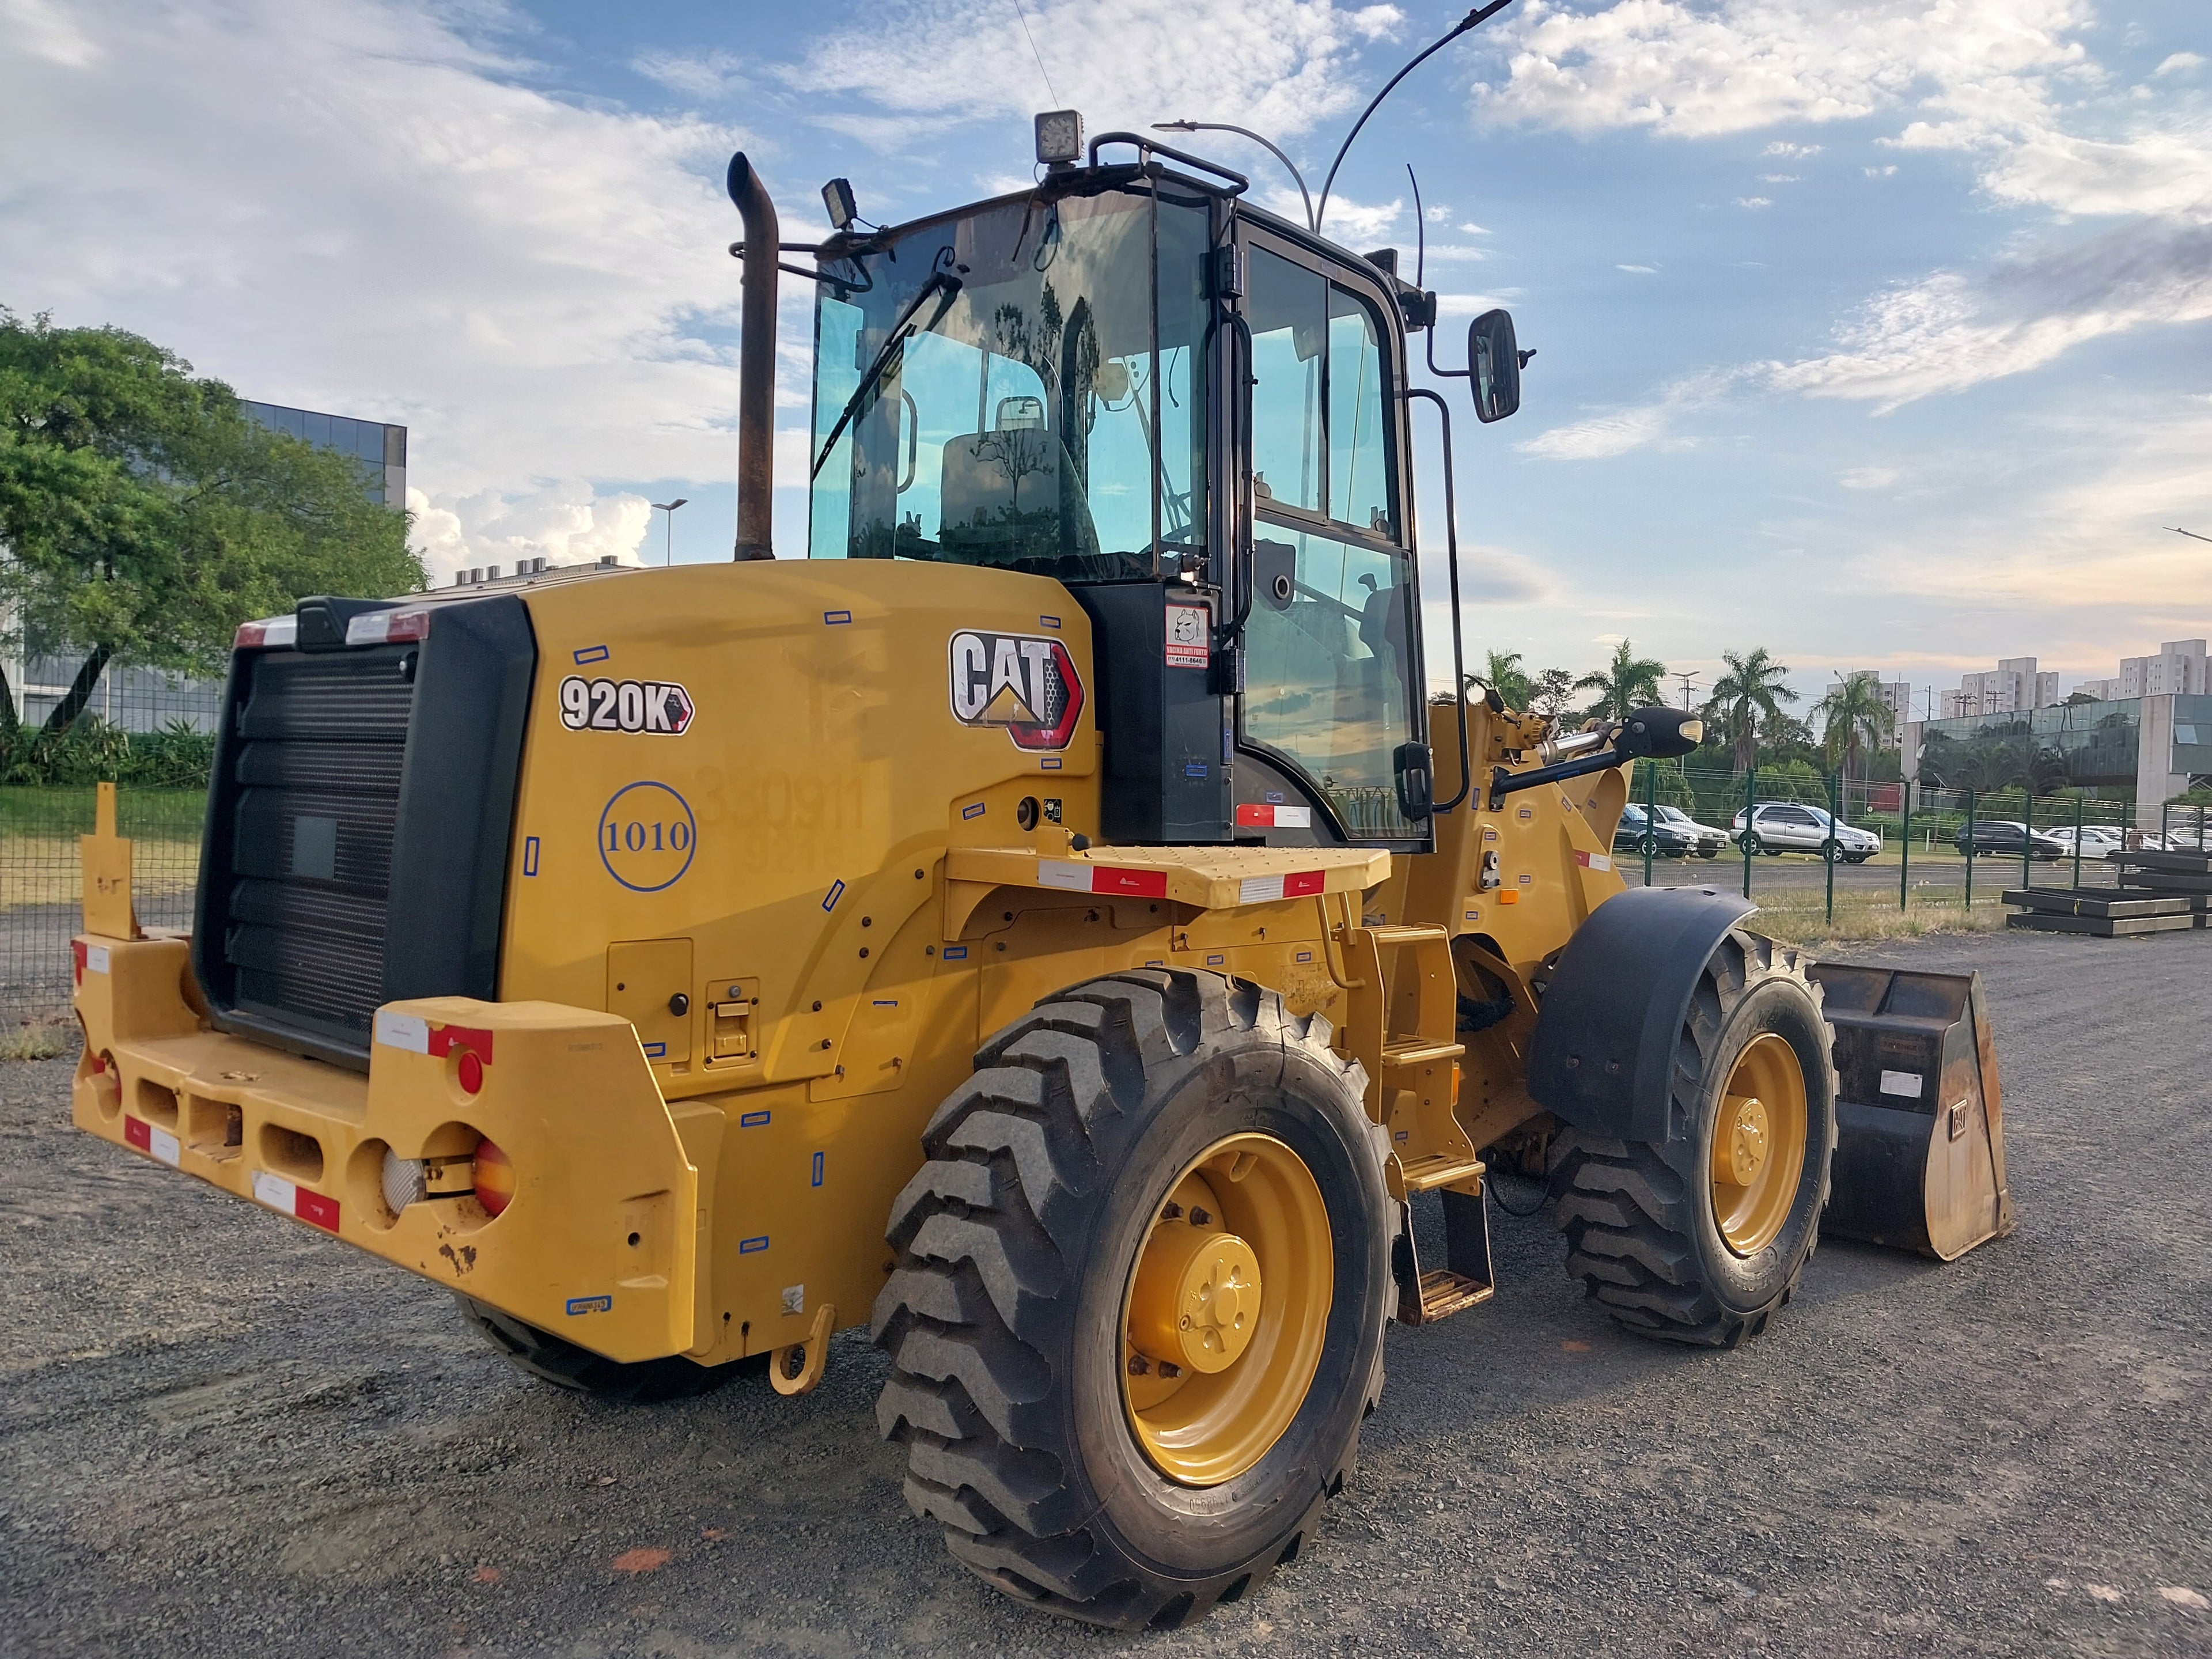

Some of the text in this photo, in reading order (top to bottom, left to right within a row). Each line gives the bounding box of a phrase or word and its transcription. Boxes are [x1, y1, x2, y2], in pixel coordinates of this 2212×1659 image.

[562, 677, 673, 732] 920K
[953, 634, 1051, 722] CAT
[606, 821, 690, 853] 1010
